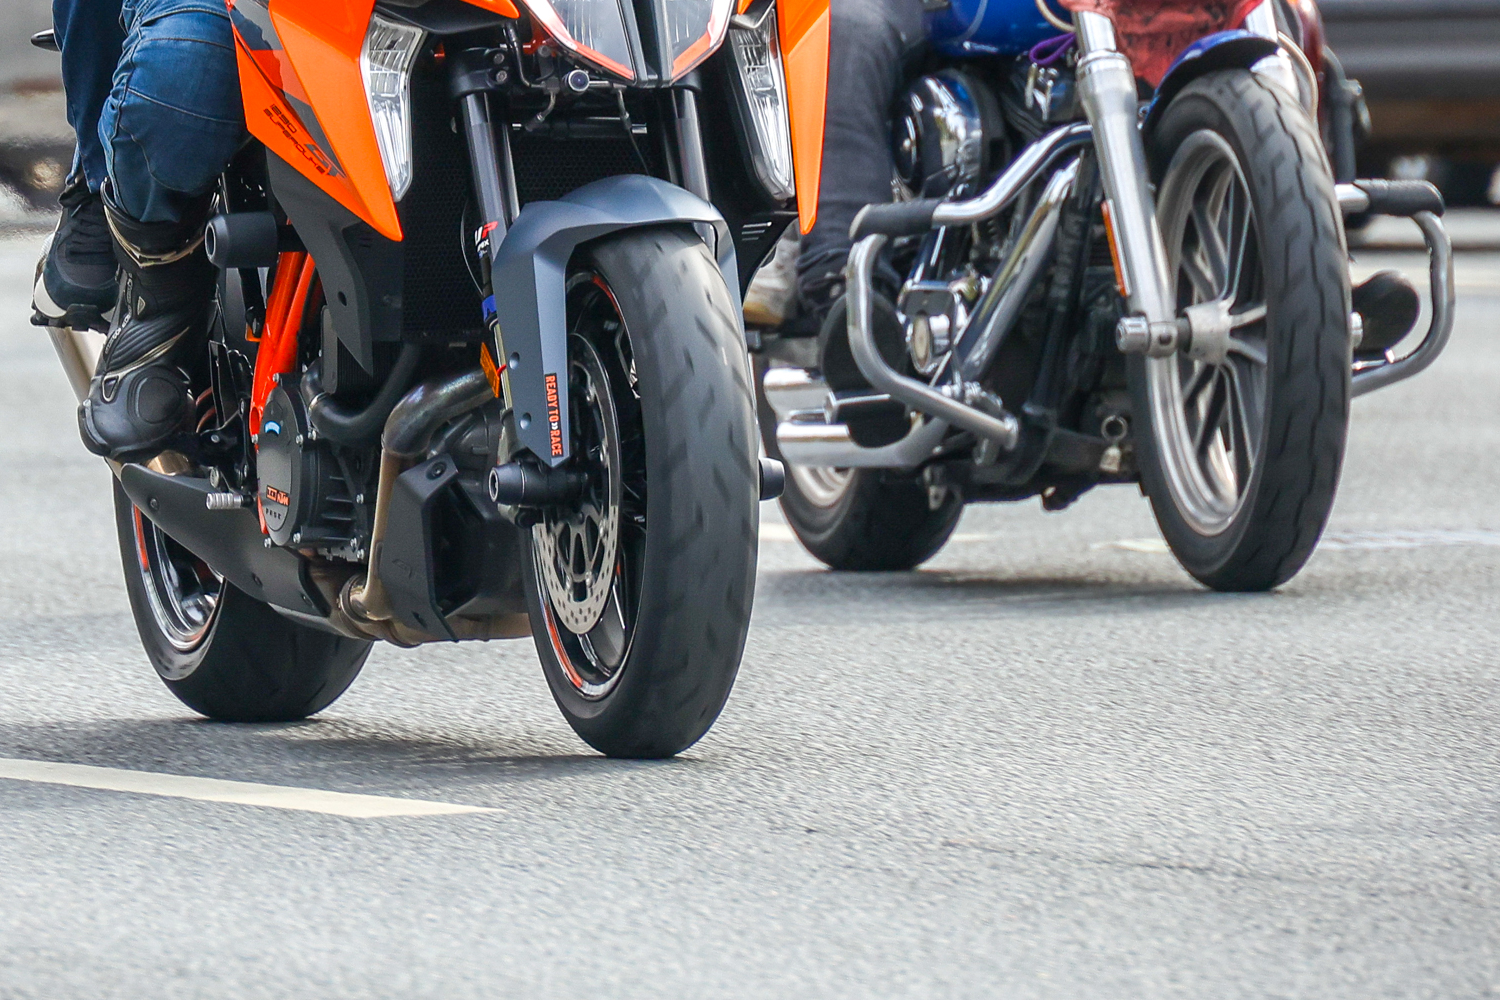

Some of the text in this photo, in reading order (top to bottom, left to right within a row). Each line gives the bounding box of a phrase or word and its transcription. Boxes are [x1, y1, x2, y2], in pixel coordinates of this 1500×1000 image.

[545, 375, 563, 457] READY TO RACE
